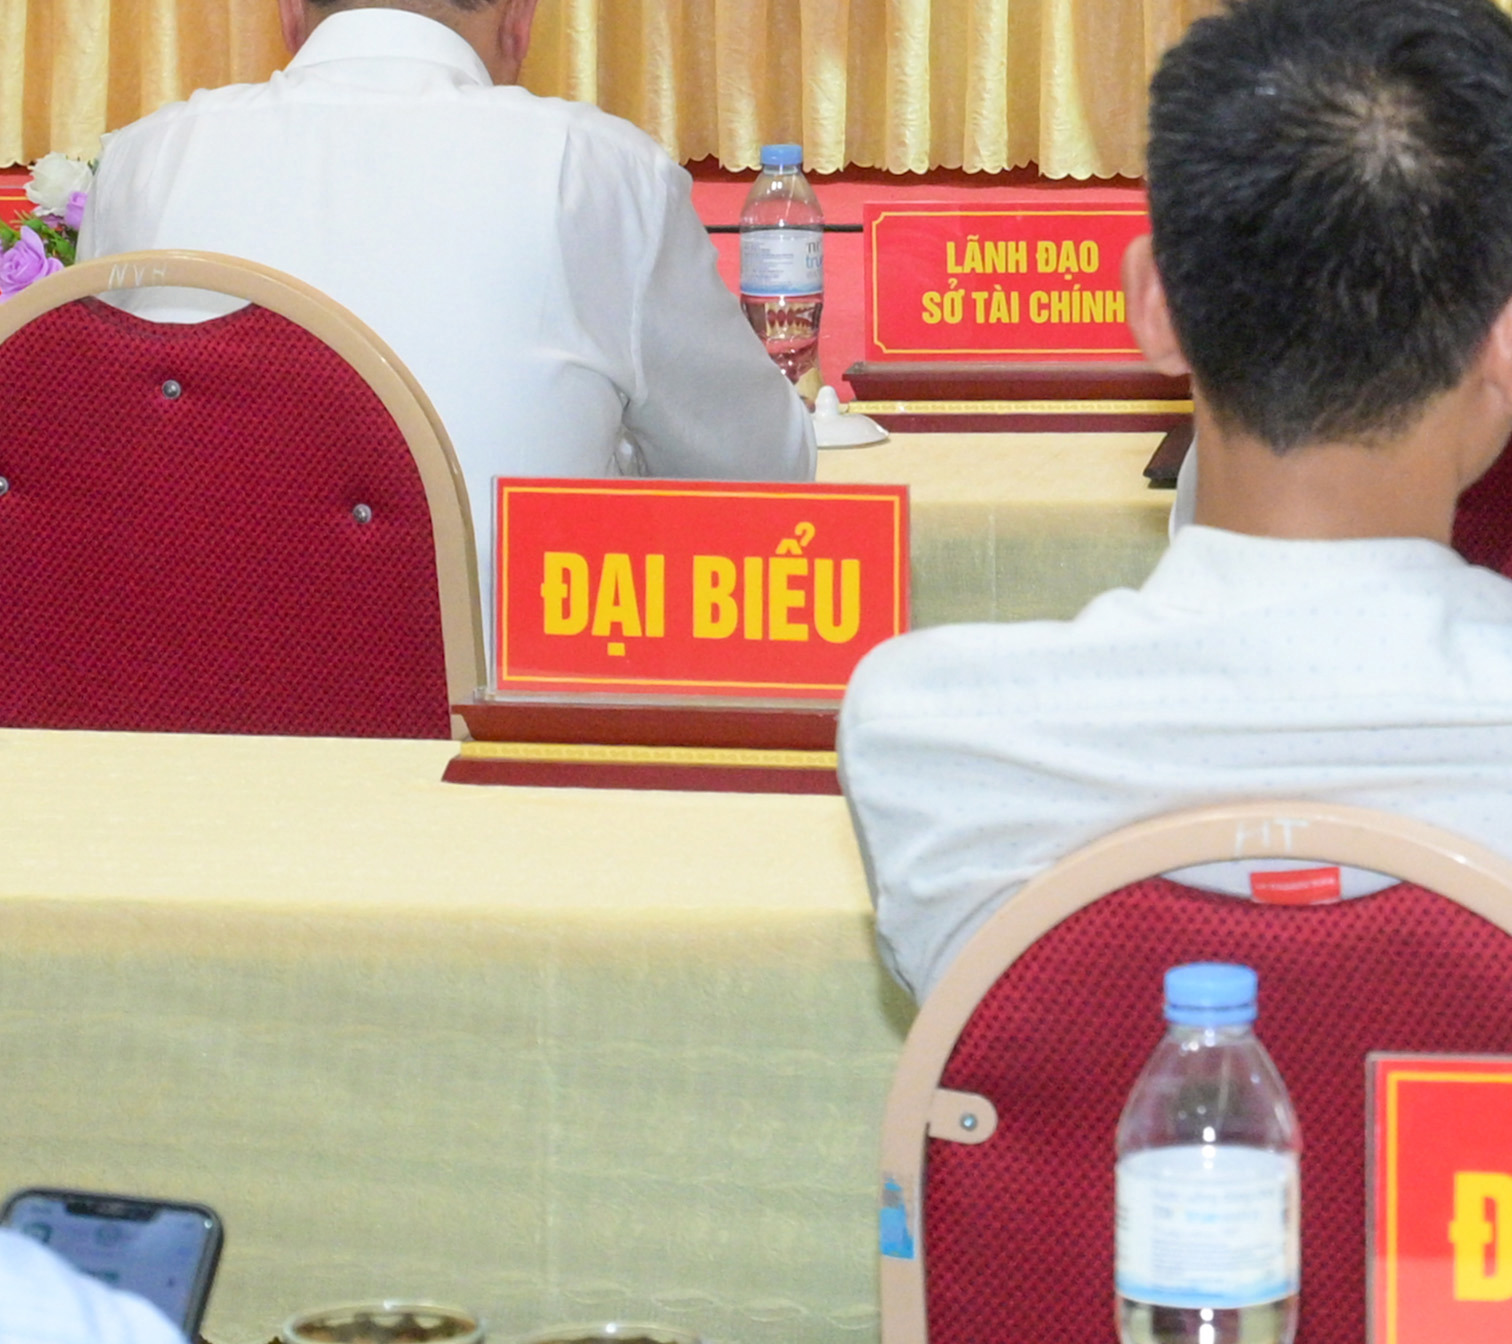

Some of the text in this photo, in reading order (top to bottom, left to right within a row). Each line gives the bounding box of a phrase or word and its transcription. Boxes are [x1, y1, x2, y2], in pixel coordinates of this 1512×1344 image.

[946, 234, 1099, 280] LÃNH ĐẠO
[921, 277, 1125, 325] SỞ TÀI CHÍNH
[540, 521, 862, 657] ĐẠI BIỂU
